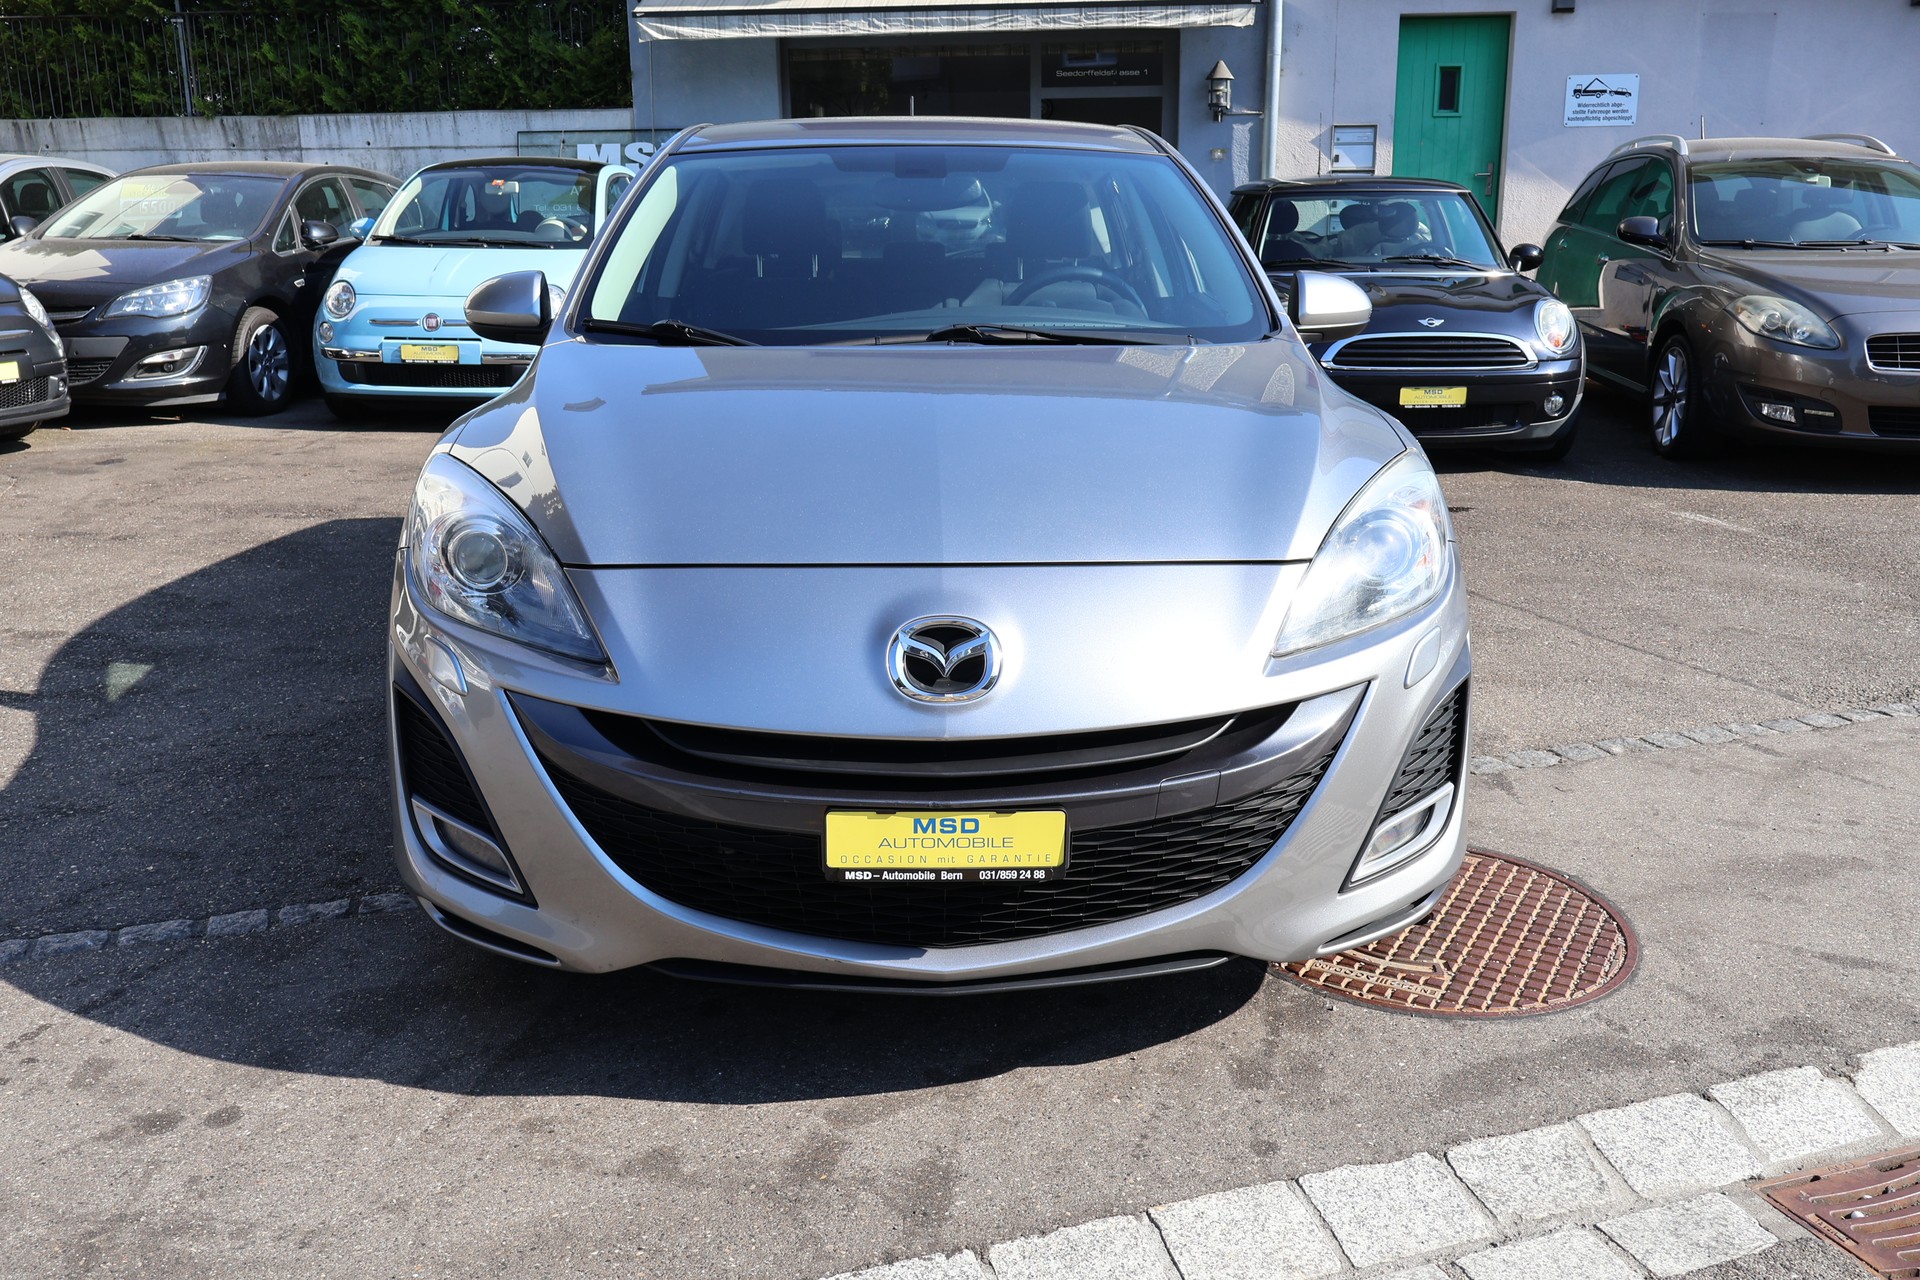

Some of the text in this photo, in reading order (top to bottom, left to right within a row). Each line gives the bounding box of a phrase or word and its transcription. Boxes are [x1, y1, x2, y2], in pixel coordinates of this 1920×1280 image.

[577, 142, 667, 172] MS
[913, 818, 980, 834] MSD
[878, 837, 1014, 849] AUTOMOBILE
[840, 853, 1052, 864] OCCASION mit GARANTIE
[882, 870, 936, 880] Automobile
[941, 870, 963, 880] Bern
[979, 870, 1018, 880] 031/859
[1019, 870, 1032, 880] 24
[1033, 869, 1046, 879] 88
